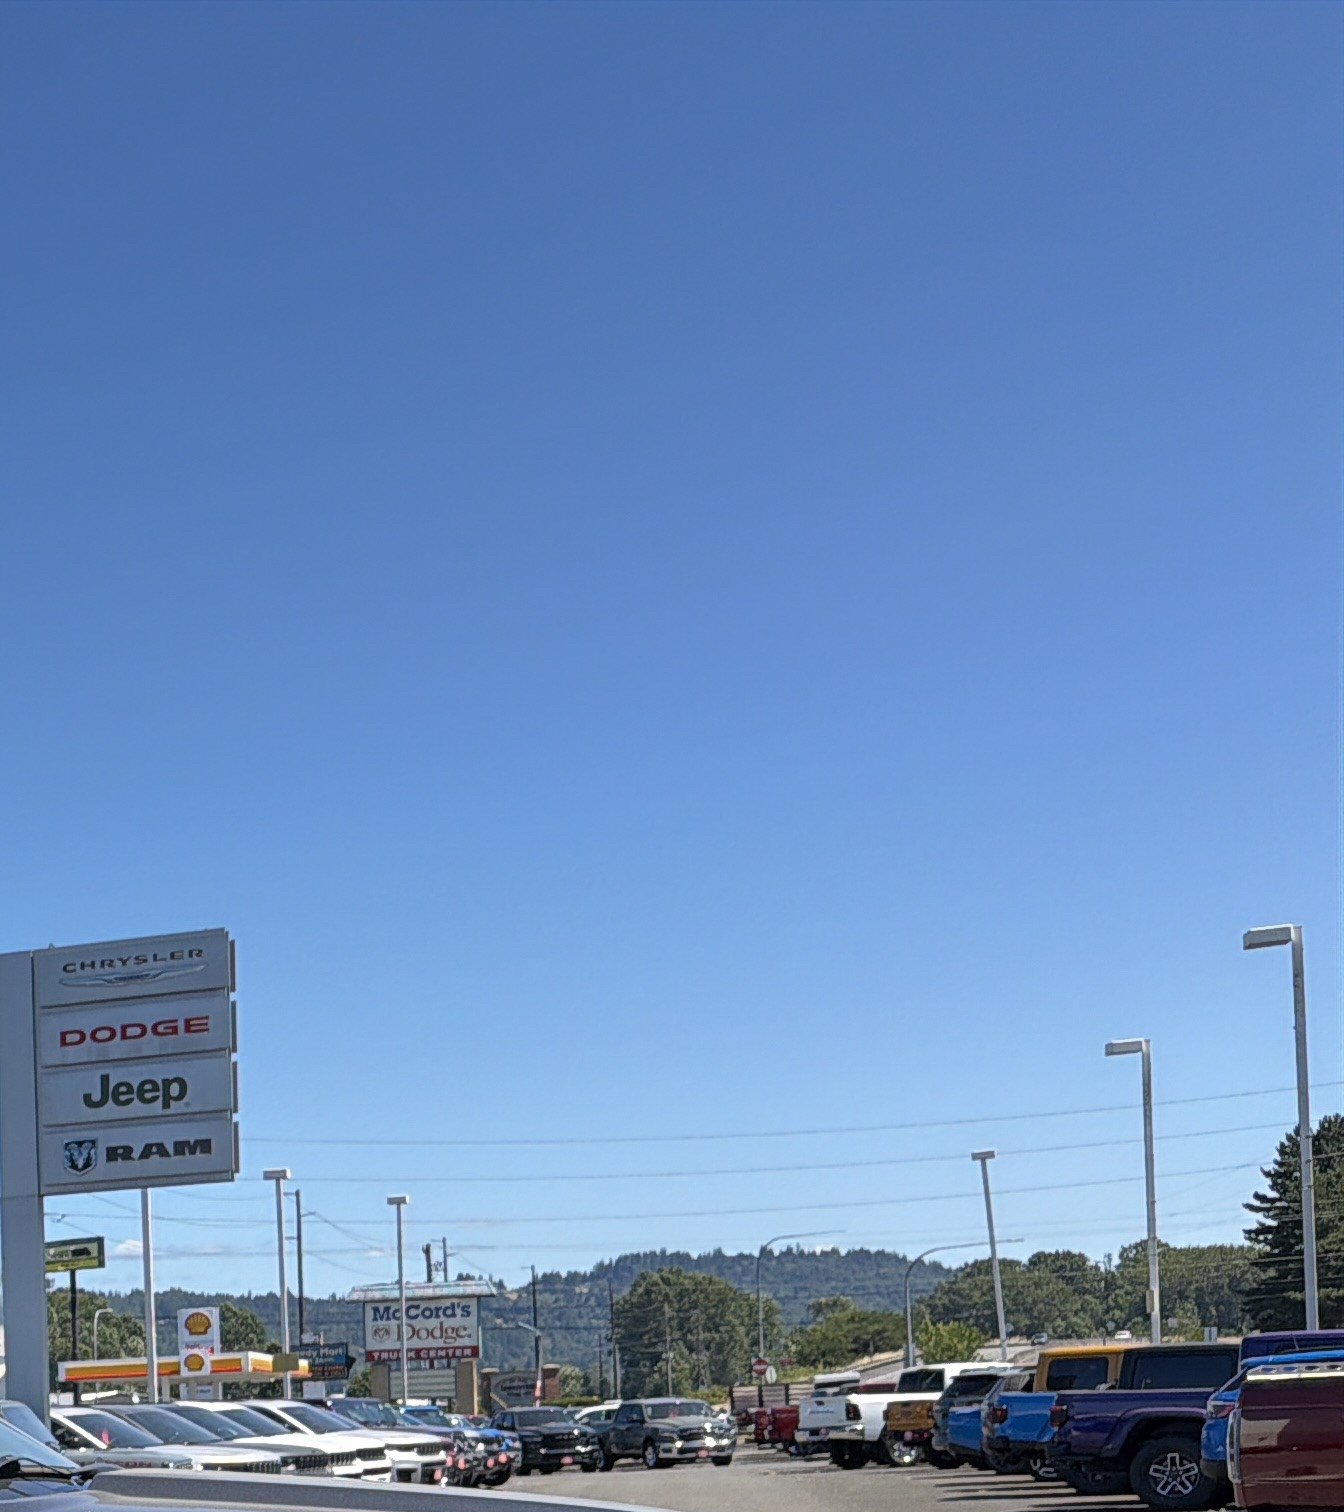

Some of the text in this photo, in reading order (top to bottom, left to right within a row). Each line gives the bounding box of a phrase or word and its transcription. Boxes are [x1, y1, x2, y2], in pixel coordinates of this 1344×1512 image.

[62, 949, 204, 973] CHRYSLER
[59, 1015, 210, 1048] DODGE
[82, 1073, 188, 1109] Jeep
[105, 1138, 212, 1163] RAM
[372, 1301, 472, 1322] McCord's
[420, 1348, 472, 1358] CENTER
